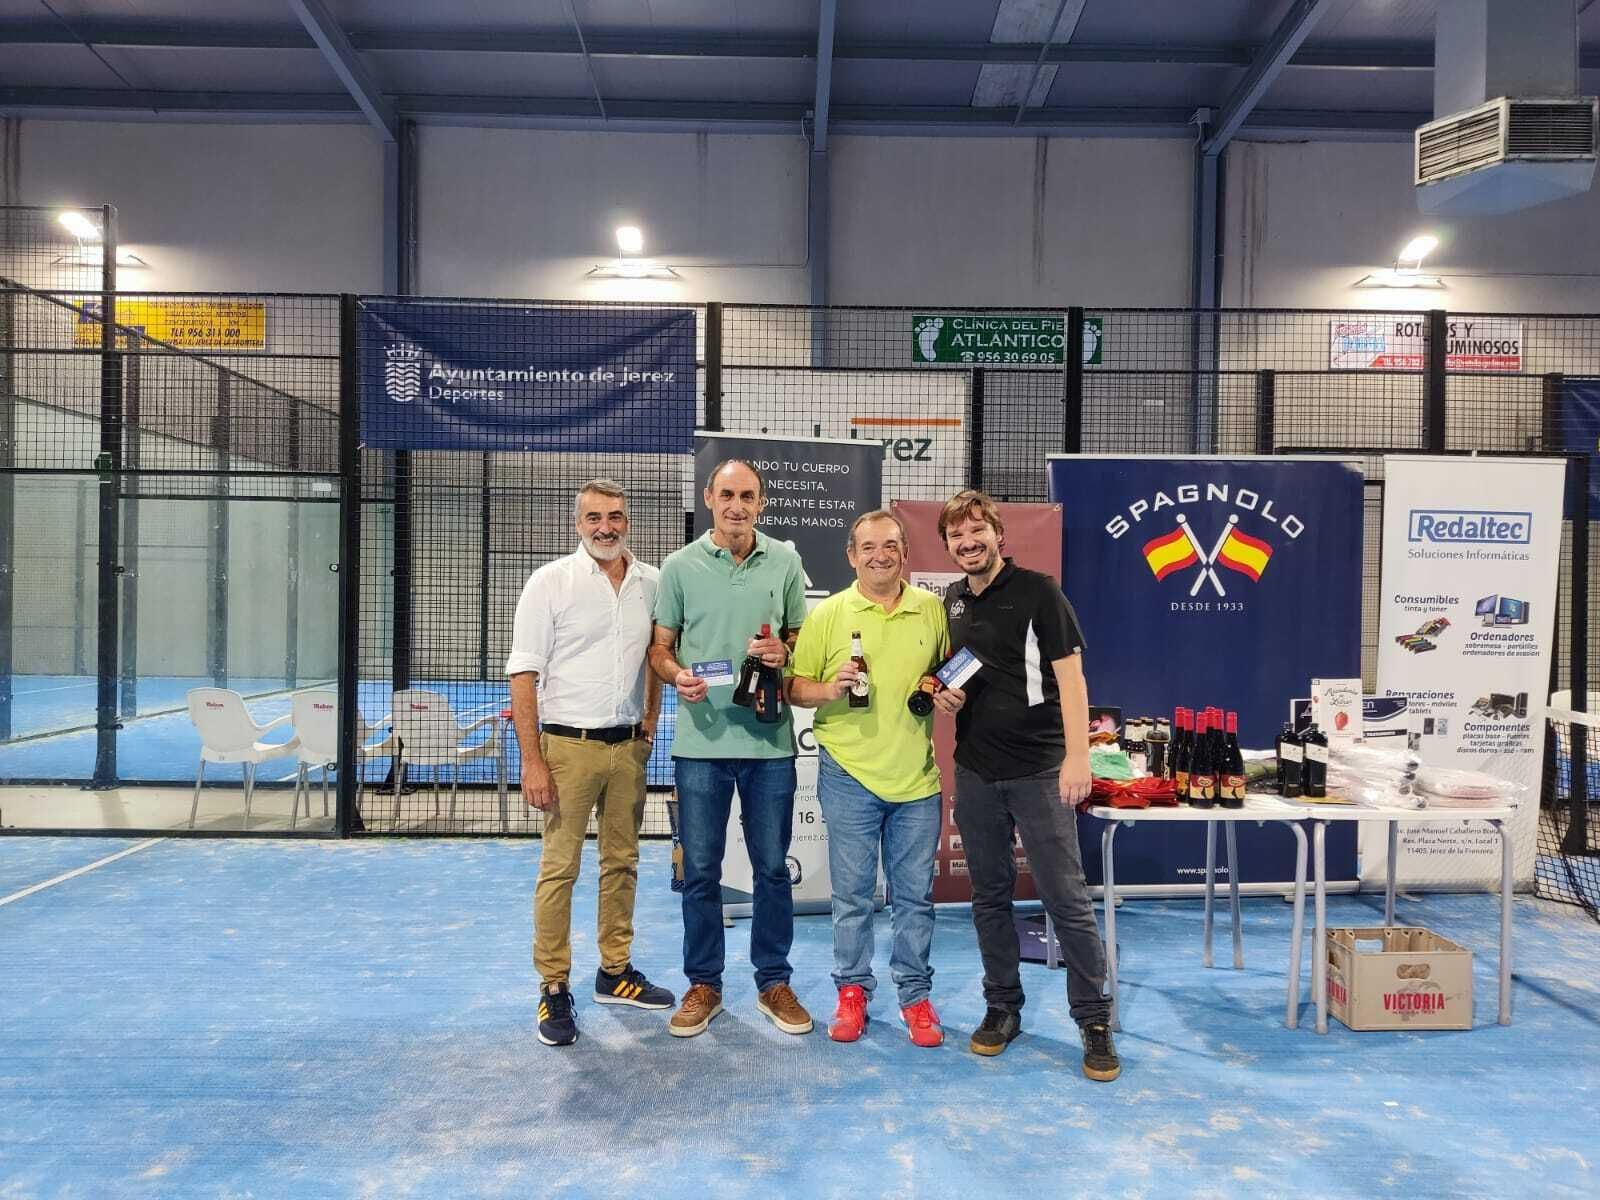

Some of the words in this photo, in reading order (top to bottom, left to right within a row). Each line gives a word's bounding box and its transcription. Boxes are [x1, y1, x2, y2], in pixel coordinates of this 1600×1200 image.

[953, 318, 1008, 330] CLÍNICA
[1012, 321, 1038, 330] DEL
[1041, 320, 1064, 331] PIE
[1465, 323, 1472, 338] Y
[187, 329, 203, 337] 956
[225, 329, 240, 337] 000
[951, 331, 1065, 348] ATLÁNTICO
[1446, 340, 1519, 355] UMINOSOS
[977, 352, 1001, 362] 956
[1003, 352, 1019, 363] 30
[1021, 353, 1038, 363] 69
[1040, 353, 1055, 363] 05
[429, 363, 584, 384] Ayuntamiento
[589, 366, 614, 382] de
[429, 386, 504, 402] Deportes
[882, 437, 932, 461] rez
[784, 462, 798, 471] TU
[802, 463, 850, 474] CUERPO
[819, 501, 855, 510] ESTAR
[1105, 483, 1305, 539] SPAGNOLO
[801, 518, 847, 528] MANOS.
[1417, 515, 1523, 539] Redaltec
[1408, 549, 1464, 560] Soluciones
[1466, 550, 1530, 561] Informáticas
[1394, 594, 1460, 605] Consumibles
[1170, 602, 1211, 611] DESDE
[1217, 602, 1244, 611] 1933
[1470, 631, 1535, 642] Ordenadores
[1464, 722, 1531, 735] Componentes
[798, 812, 815, 824] 16
[1384, 993, 1445, 1010] VICTORIA
